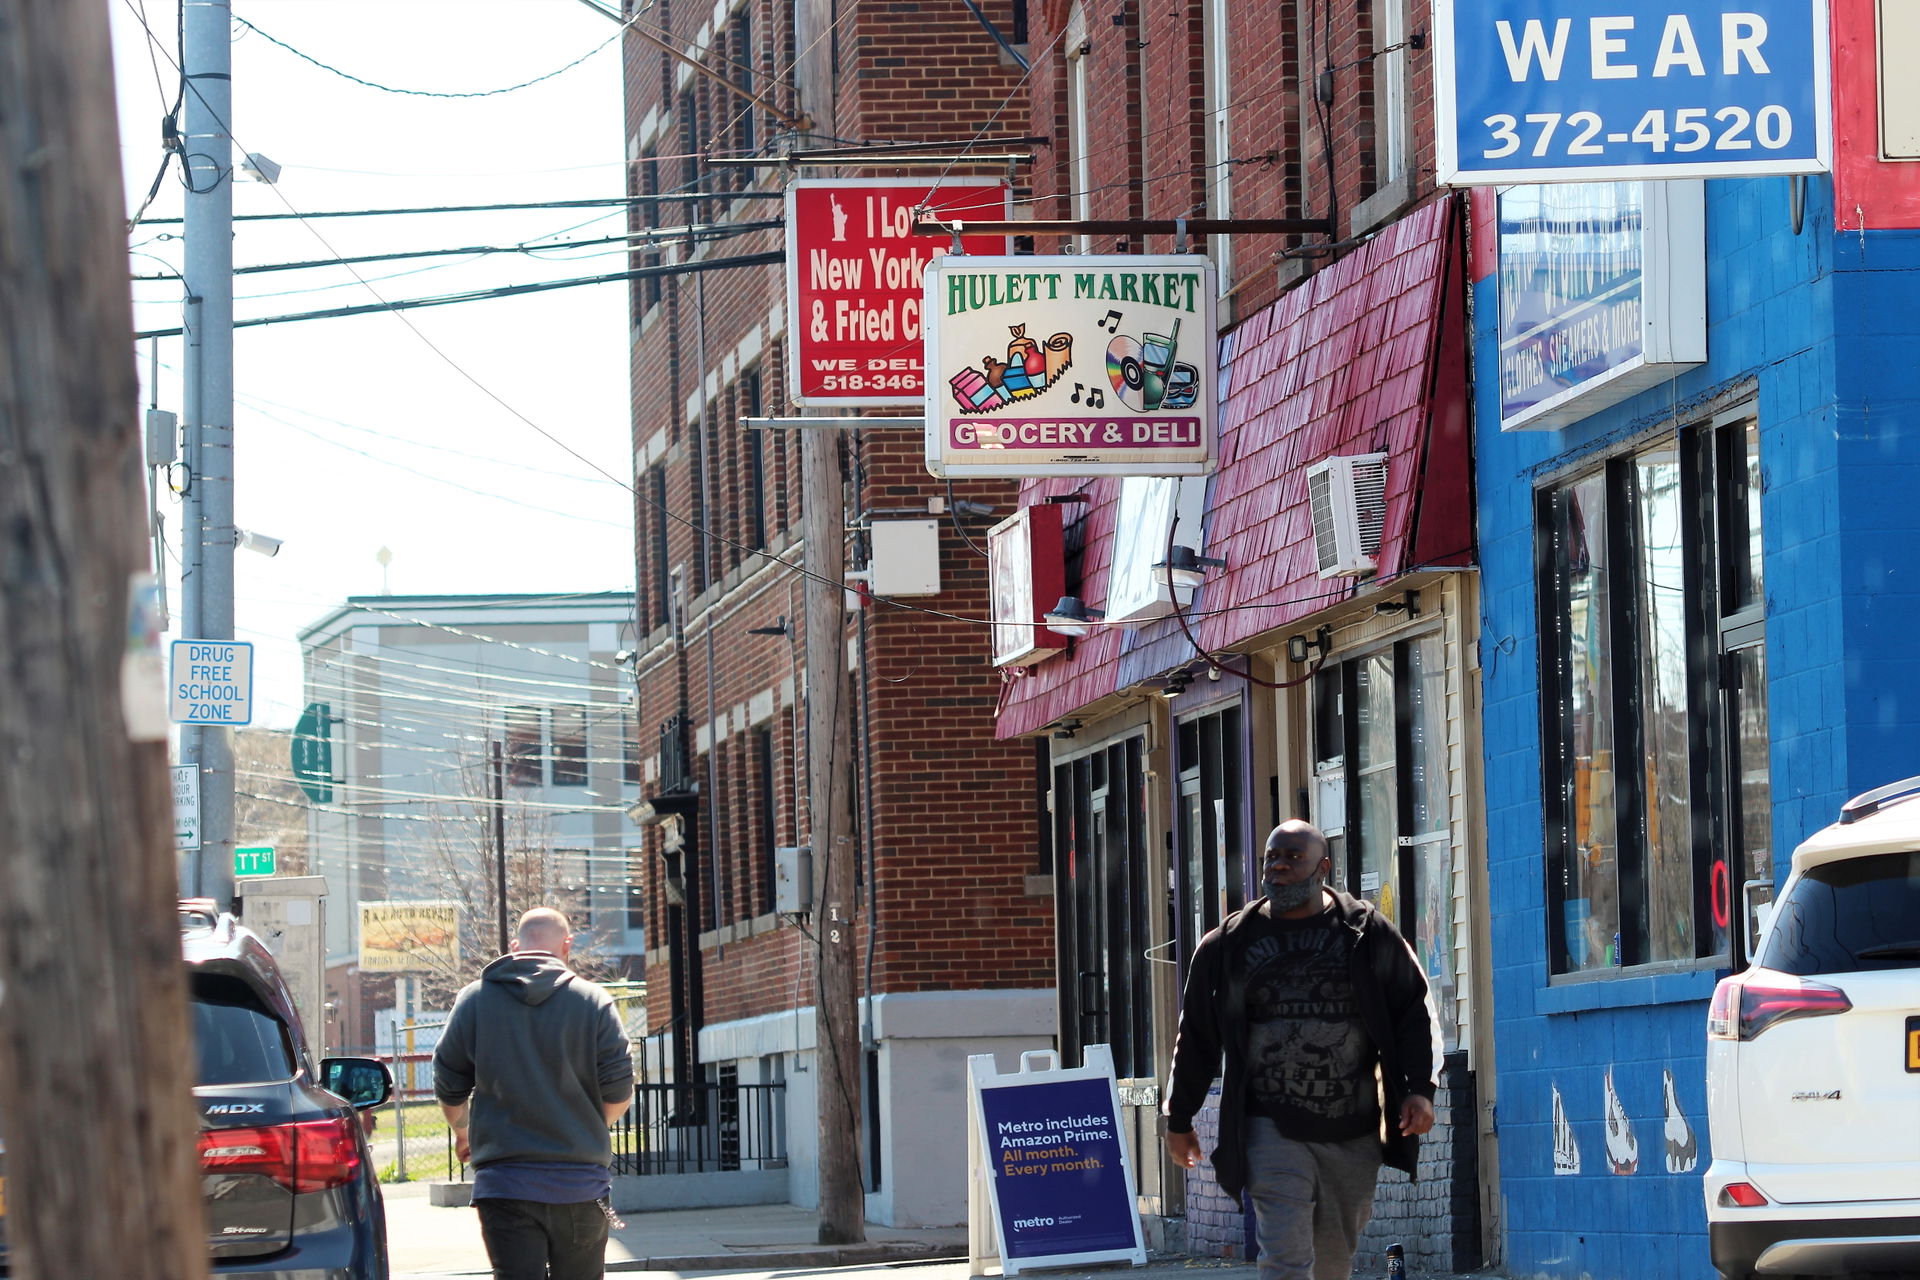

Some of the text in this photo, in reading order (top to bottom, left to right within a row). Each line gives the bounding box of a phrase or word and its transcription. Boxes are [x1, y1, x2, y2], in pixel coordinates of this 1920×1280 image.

[1495, 12, 1771, 83] WEAR
[1482, 104, 1793, 160] 372-4520
[866, 195, 874, 239] I
[810, 247, 924, 290] New York
[947, 272, 1200, 316] HULETT MARKET
[811, 299, 829, 342] &
[836, 298, 895, 342] Fried
[1505, 296, 1640, 399] CLOTHES SNEAKERS & MORE
[811, 358, 925, 371] WE DEL
[822, 374, 924, 391] 518-346-
[954, 421, 1196, 446] GOCERY & DELI
[189, 646, 235, 663] DRUG
[190, 666, 232, 682] FREE
[178, 683, 244, 701] SCHOOL
[188, 703, 233, 720] ZONE
[175, 795, 195, 807] RKING
[236, 852, 271, 871] TT ST
[1266, 1002, 1353, 1016] OTIVAT
[1252, 1077, 1358, 1097] ONEY
[206, 1103, 265, 1115] MDX
[998, 1114, 1109, 1135] Metro includes
[1000, 1128, 1112, 1149] Amazon Prime.
[1003, 1145, 1079, 1162] All month.
[1004, 1157, 1105, 1177] Every month.
[1013, 1215, 1054, 1229] metro
